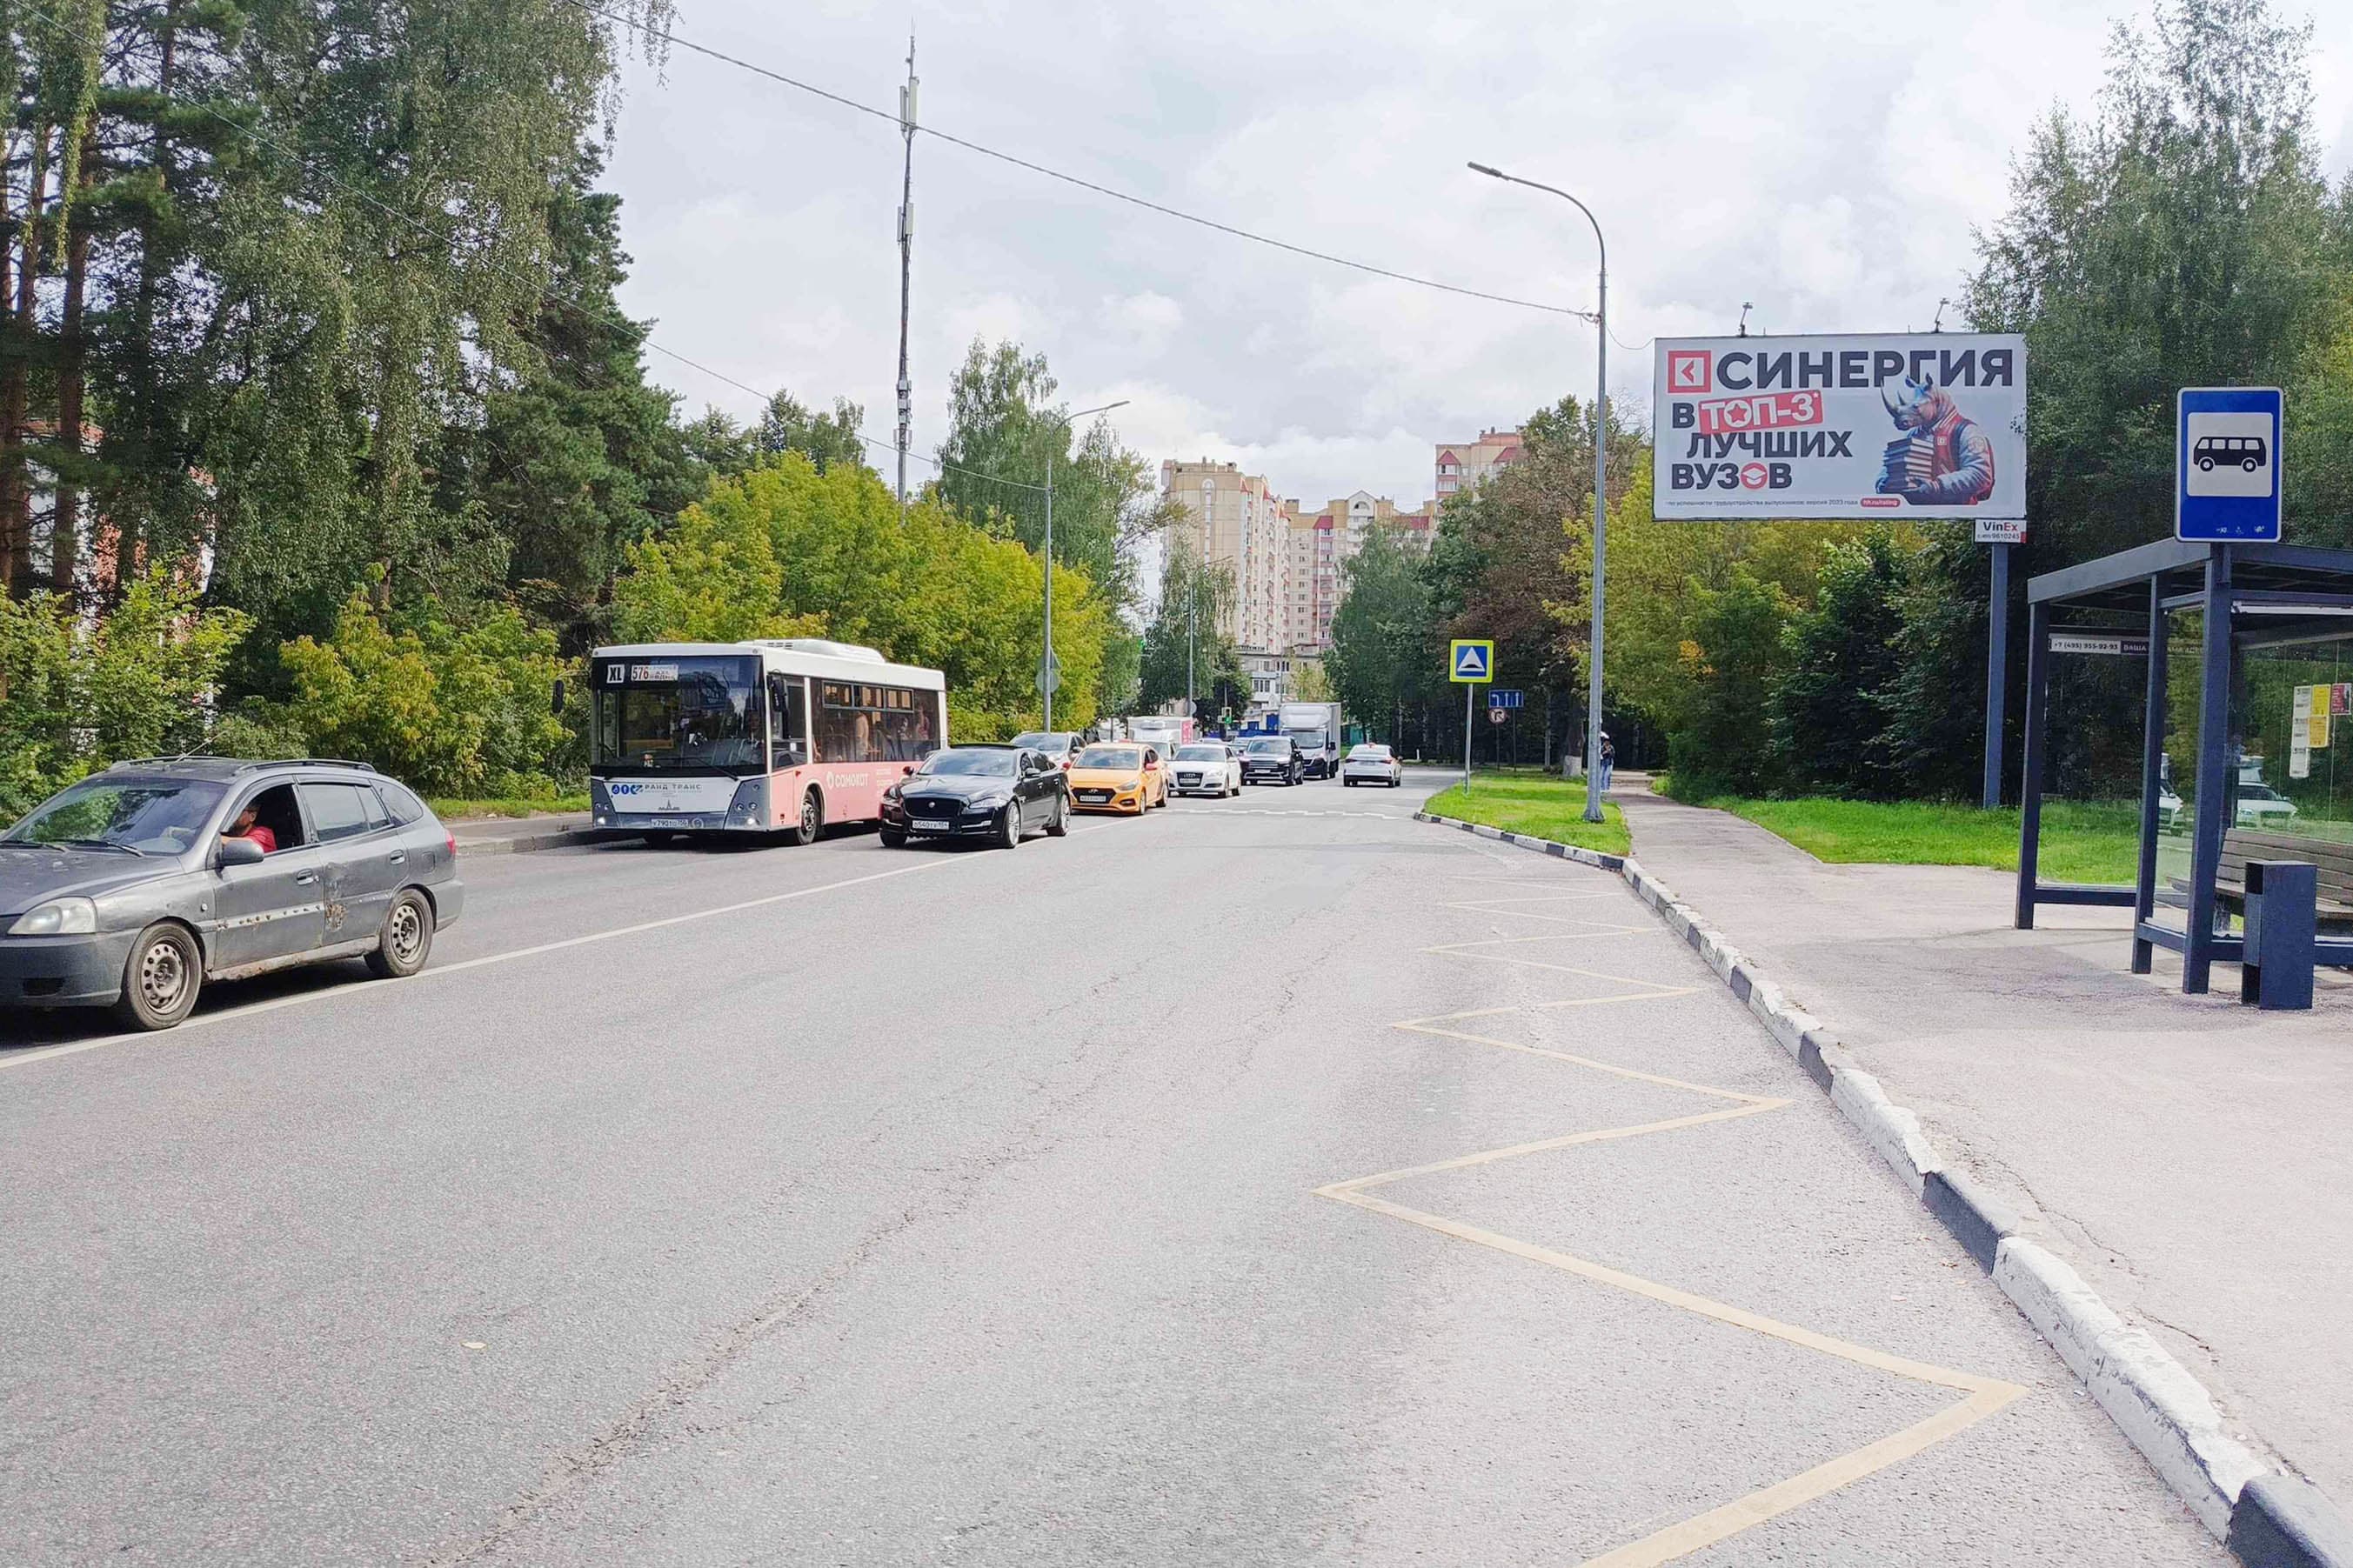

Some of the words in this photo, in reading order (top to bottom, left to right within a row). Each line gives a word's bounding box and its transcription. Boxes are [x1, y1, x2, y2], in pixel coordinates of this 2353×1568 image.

[1716, 349, 2013, 389] СИНЕРГИЯ
[1672, 402, 1695, 429] В
[1687, 431, 1853, 459] ЛУЧШИХ
[1672, 462, 1792, 490] ВУЗОВ
[1983, 521, 2018, 531] VinEx
[609, 667, 622, 682] XL
[632, 667, 649, 680] 576
